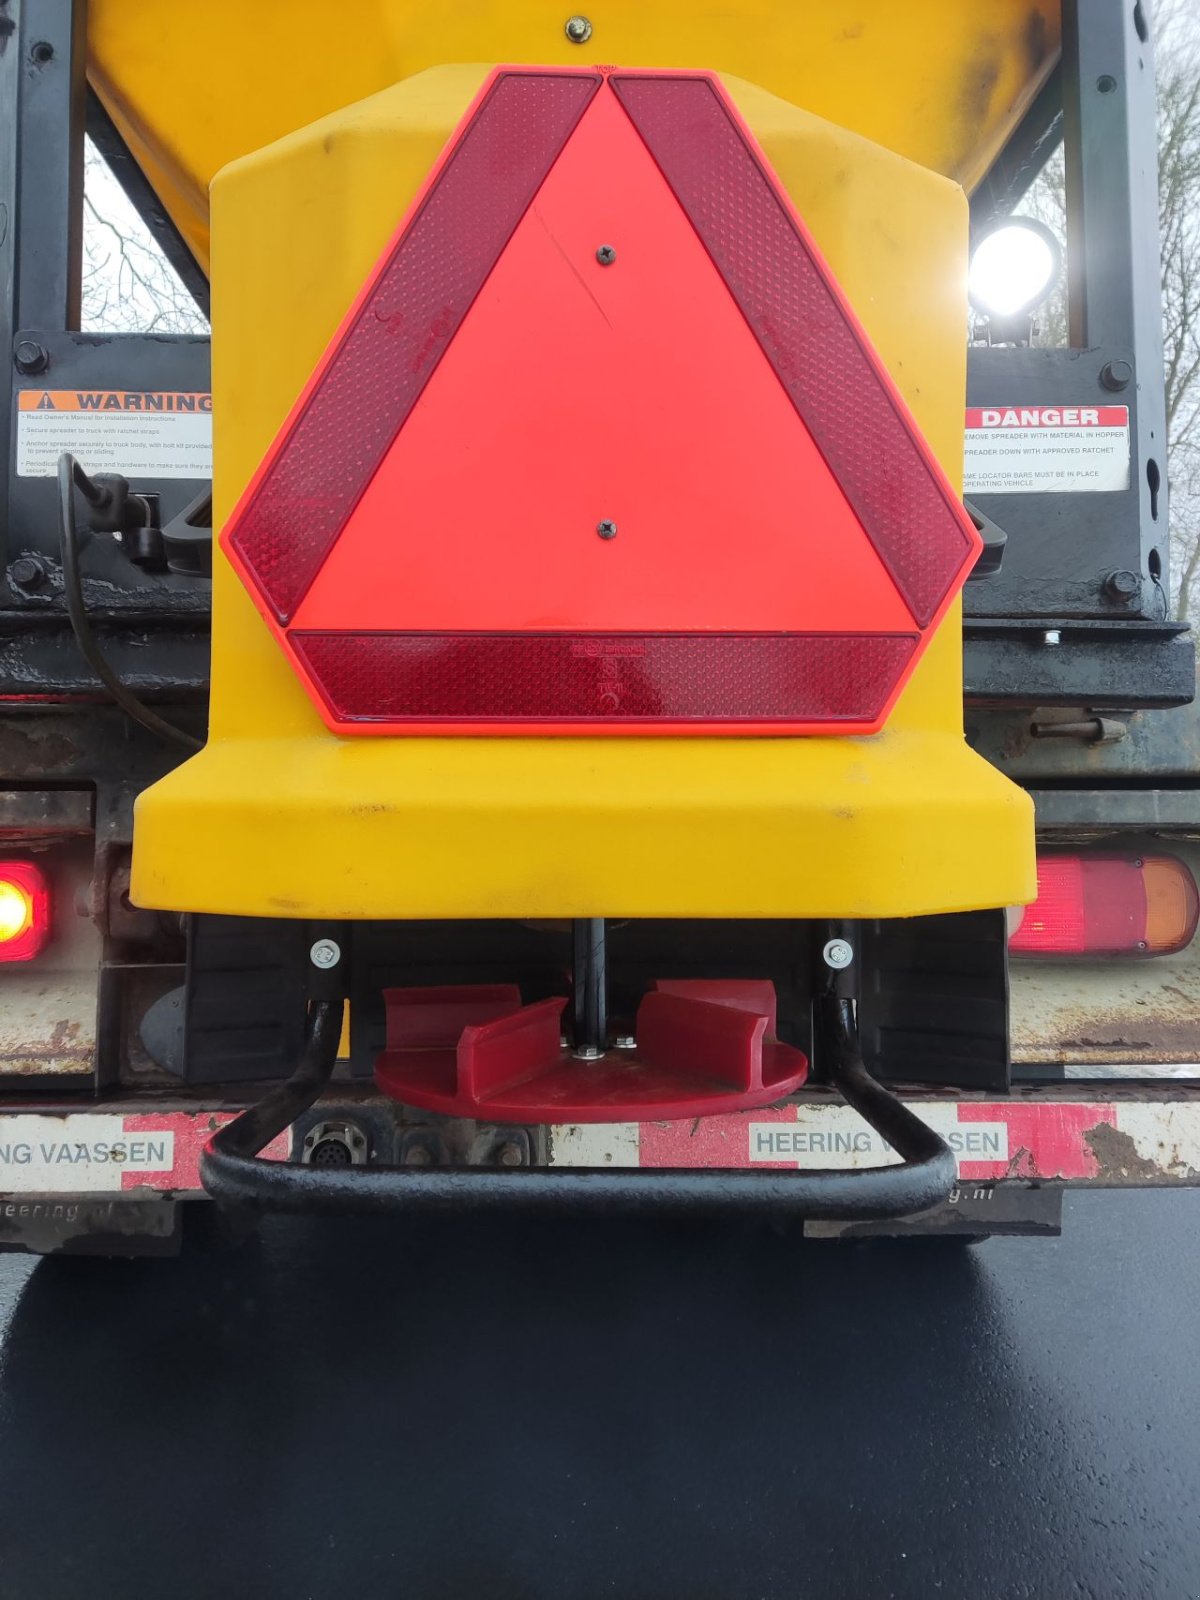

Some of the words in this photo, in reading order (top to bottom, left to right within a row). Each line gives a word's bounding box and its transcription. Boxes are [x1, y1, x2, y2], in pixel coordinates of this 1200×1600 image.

[77, 393, 213, 412] WARNING
[982, 409, 1099, 427] DANGER
[991, 432, 1029, 440] SPREADER
[1031, 432, 1048, 440] WITH
[1042, 447, 1081, 455] APPROVED
[1083, 446, 1115, 454] RATCHET
[1004, 479, 1033, 487] VEHICLE
[757, 1132, 872, 1153] HEERING
[40, 1141, 165, 1164] VAASSEN
